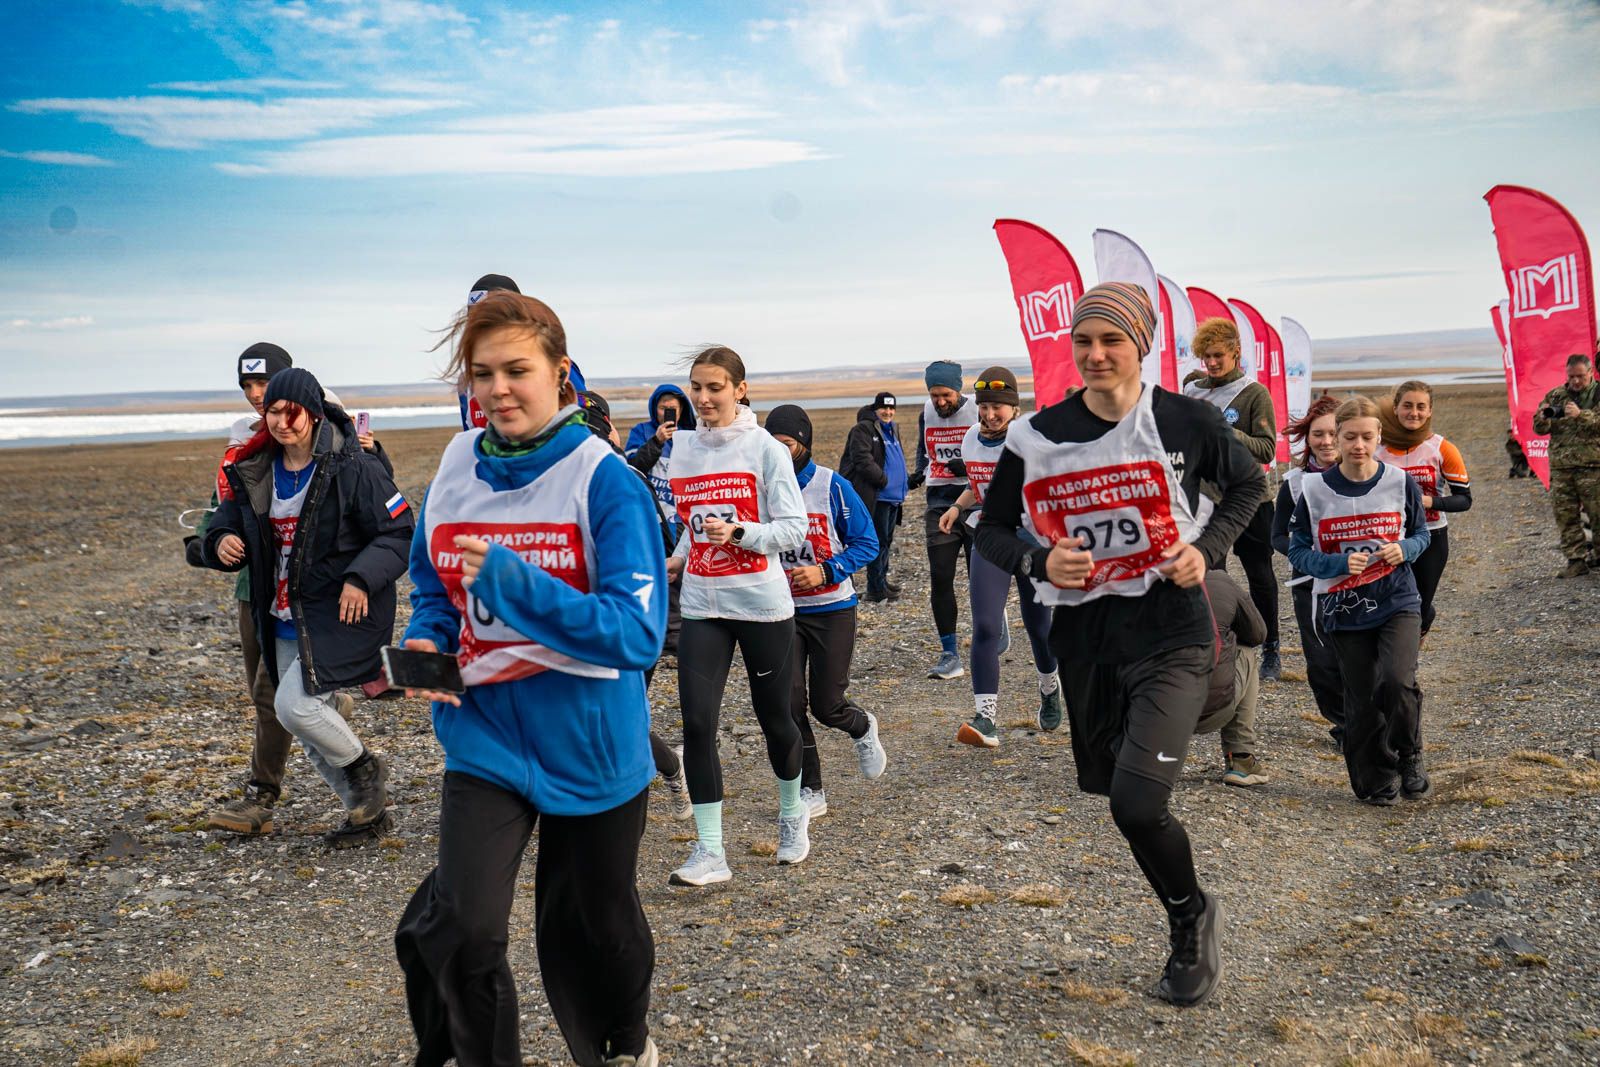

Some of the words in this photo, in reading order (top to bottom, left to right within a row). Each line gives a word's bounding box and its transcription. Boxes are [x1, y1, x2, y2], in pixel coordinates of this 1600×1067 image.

[684, 477, 747, 493] ЛАБОРАТОРИЯ
[1049, 469, 1151, 497] ЛАБОРАТОРИЯ
[674, 486, 752, 504] ПУТЕШЕСТВИЙ
[1036, 479, 1161, 514] ПУТЕШЕСТВИЙ
[1321, 524, 1399, 541] ПУТЕШЕСТВИЙ
[1330, 516, 1397, 531] ЛАБОРАТОРИЯ
[1073, 518, 1141, 551] 079
[437, 548, 577, 569] ПУТВИЙ
